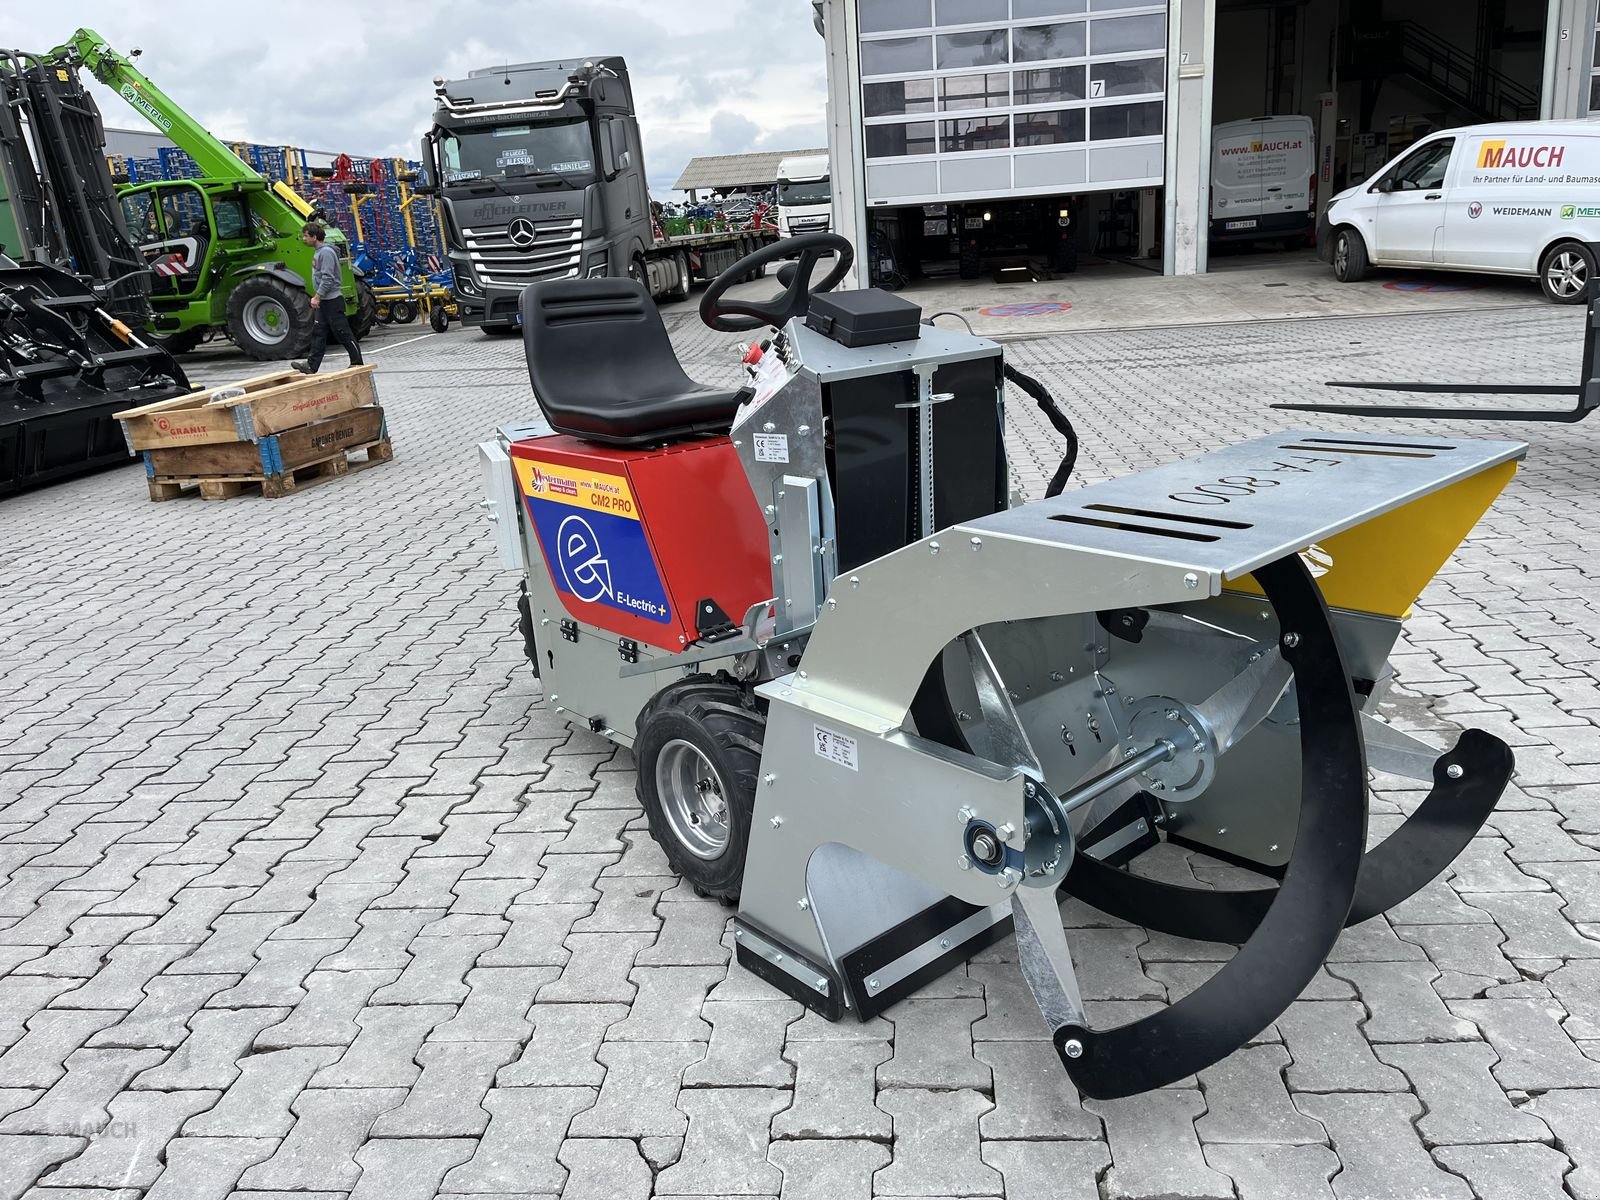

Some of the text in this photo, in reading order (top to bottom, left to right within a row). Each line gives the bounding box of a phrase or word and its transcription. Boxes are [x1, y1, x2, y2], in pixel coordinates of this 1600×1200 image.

[1561, 29, 1568, 40] 5
[1182, 53, 1188, 63] 7
[1092, 82, 1102, 96] 7
[136, 96, 172, 129] MERLO
[1221, 140, 1303, 156] www.MAUCH.at
[506, 156, 531, 165] ALESSIO
[1482, 146, 1566, 168] MAUCH
[560, 162, 582, 171] DANIEL
[1512, 175, 1523, 183] für
[1525, 175, 1546, 183] Land-
[1548, 175, 1564, 183] und
[1493, 207, 1552, 216] WEIDEMANN
[311, 396, 326, 406] GRANIT
[170, 425, 207, 436] GRANIT
[311, 427, 354, 448] GARDNER DENVER
[531, 467, 577, 488] Westermann
[591, 493, 632, 513] CM2 PRO
[617, 592, 657, 614] E-Lectric
